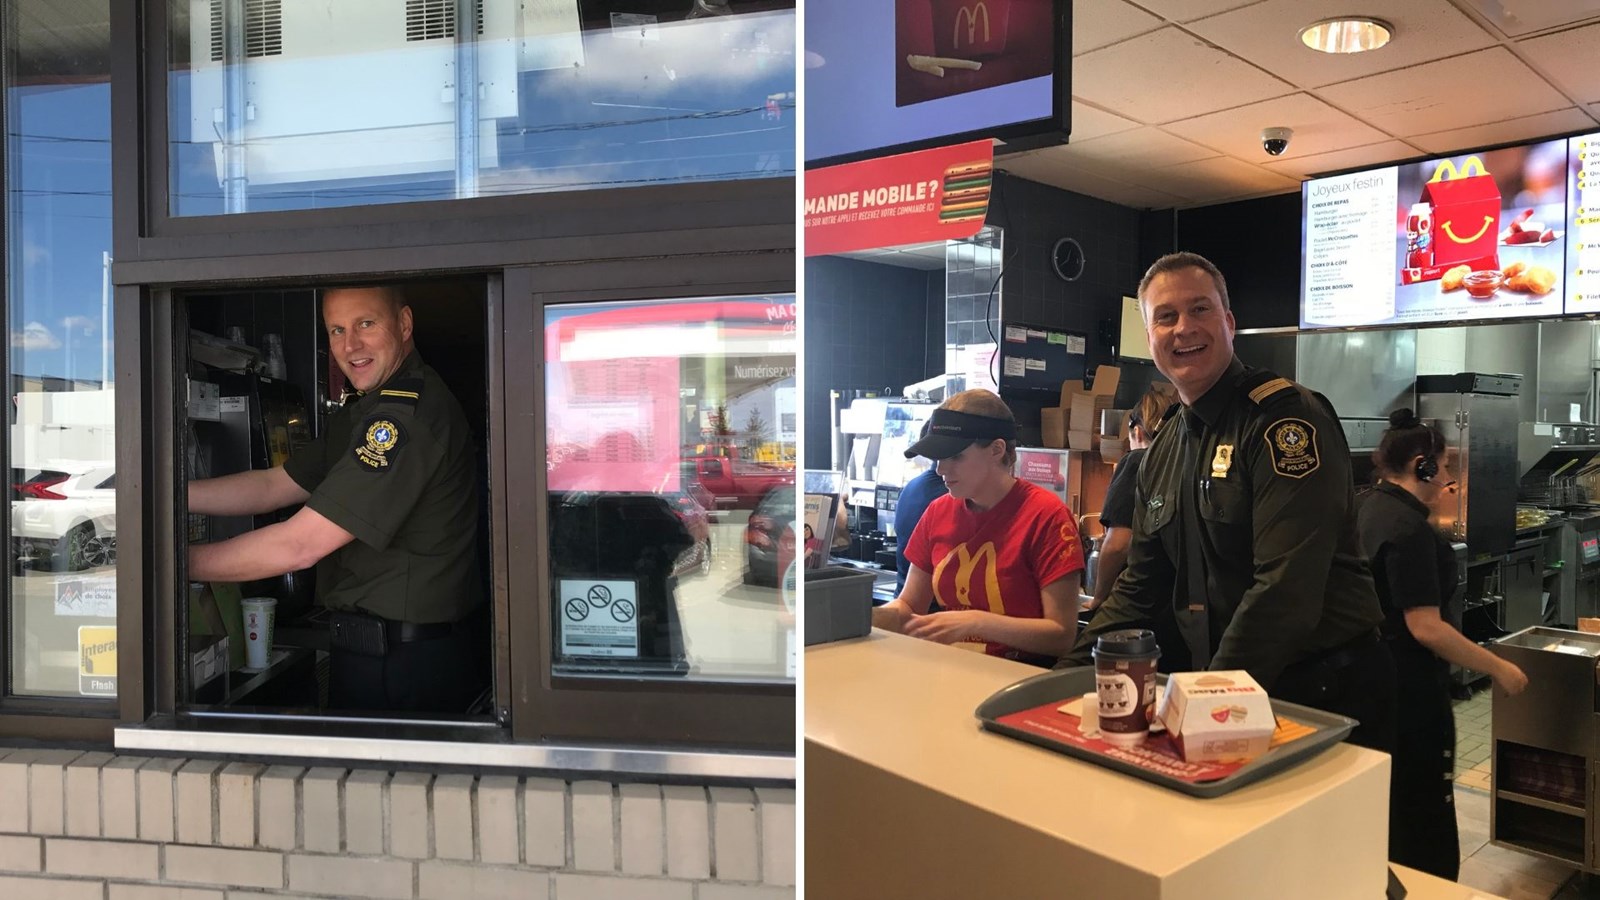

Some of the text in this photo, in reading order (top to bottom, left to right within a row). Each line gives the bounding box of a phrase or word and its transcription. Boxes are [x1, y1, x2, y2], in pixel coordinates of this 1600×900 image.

[1312, 177, 1383, 198] Joyeux festin
[804, 191, 859, 215] MANDE
[812, 217, 821, 226] SUR
[822, 215, 837, 225] NOTRE
[852, 213, 858, 222] ET
[858, 210, 880, 220] RECEVEZ
[881, 209, 896, 218] VOTRE
[897, 204, 926, 217] COMMANDE
[926, 203, 934, 212] ICI
[766, 304, 788, 321] MA
[734, 364, 784, 378] Numérisez
[360, 455, 379, 468] POLICE
[1287, 464, 1308, 472] POLICE
[91, 680, 114, 690] Flash
